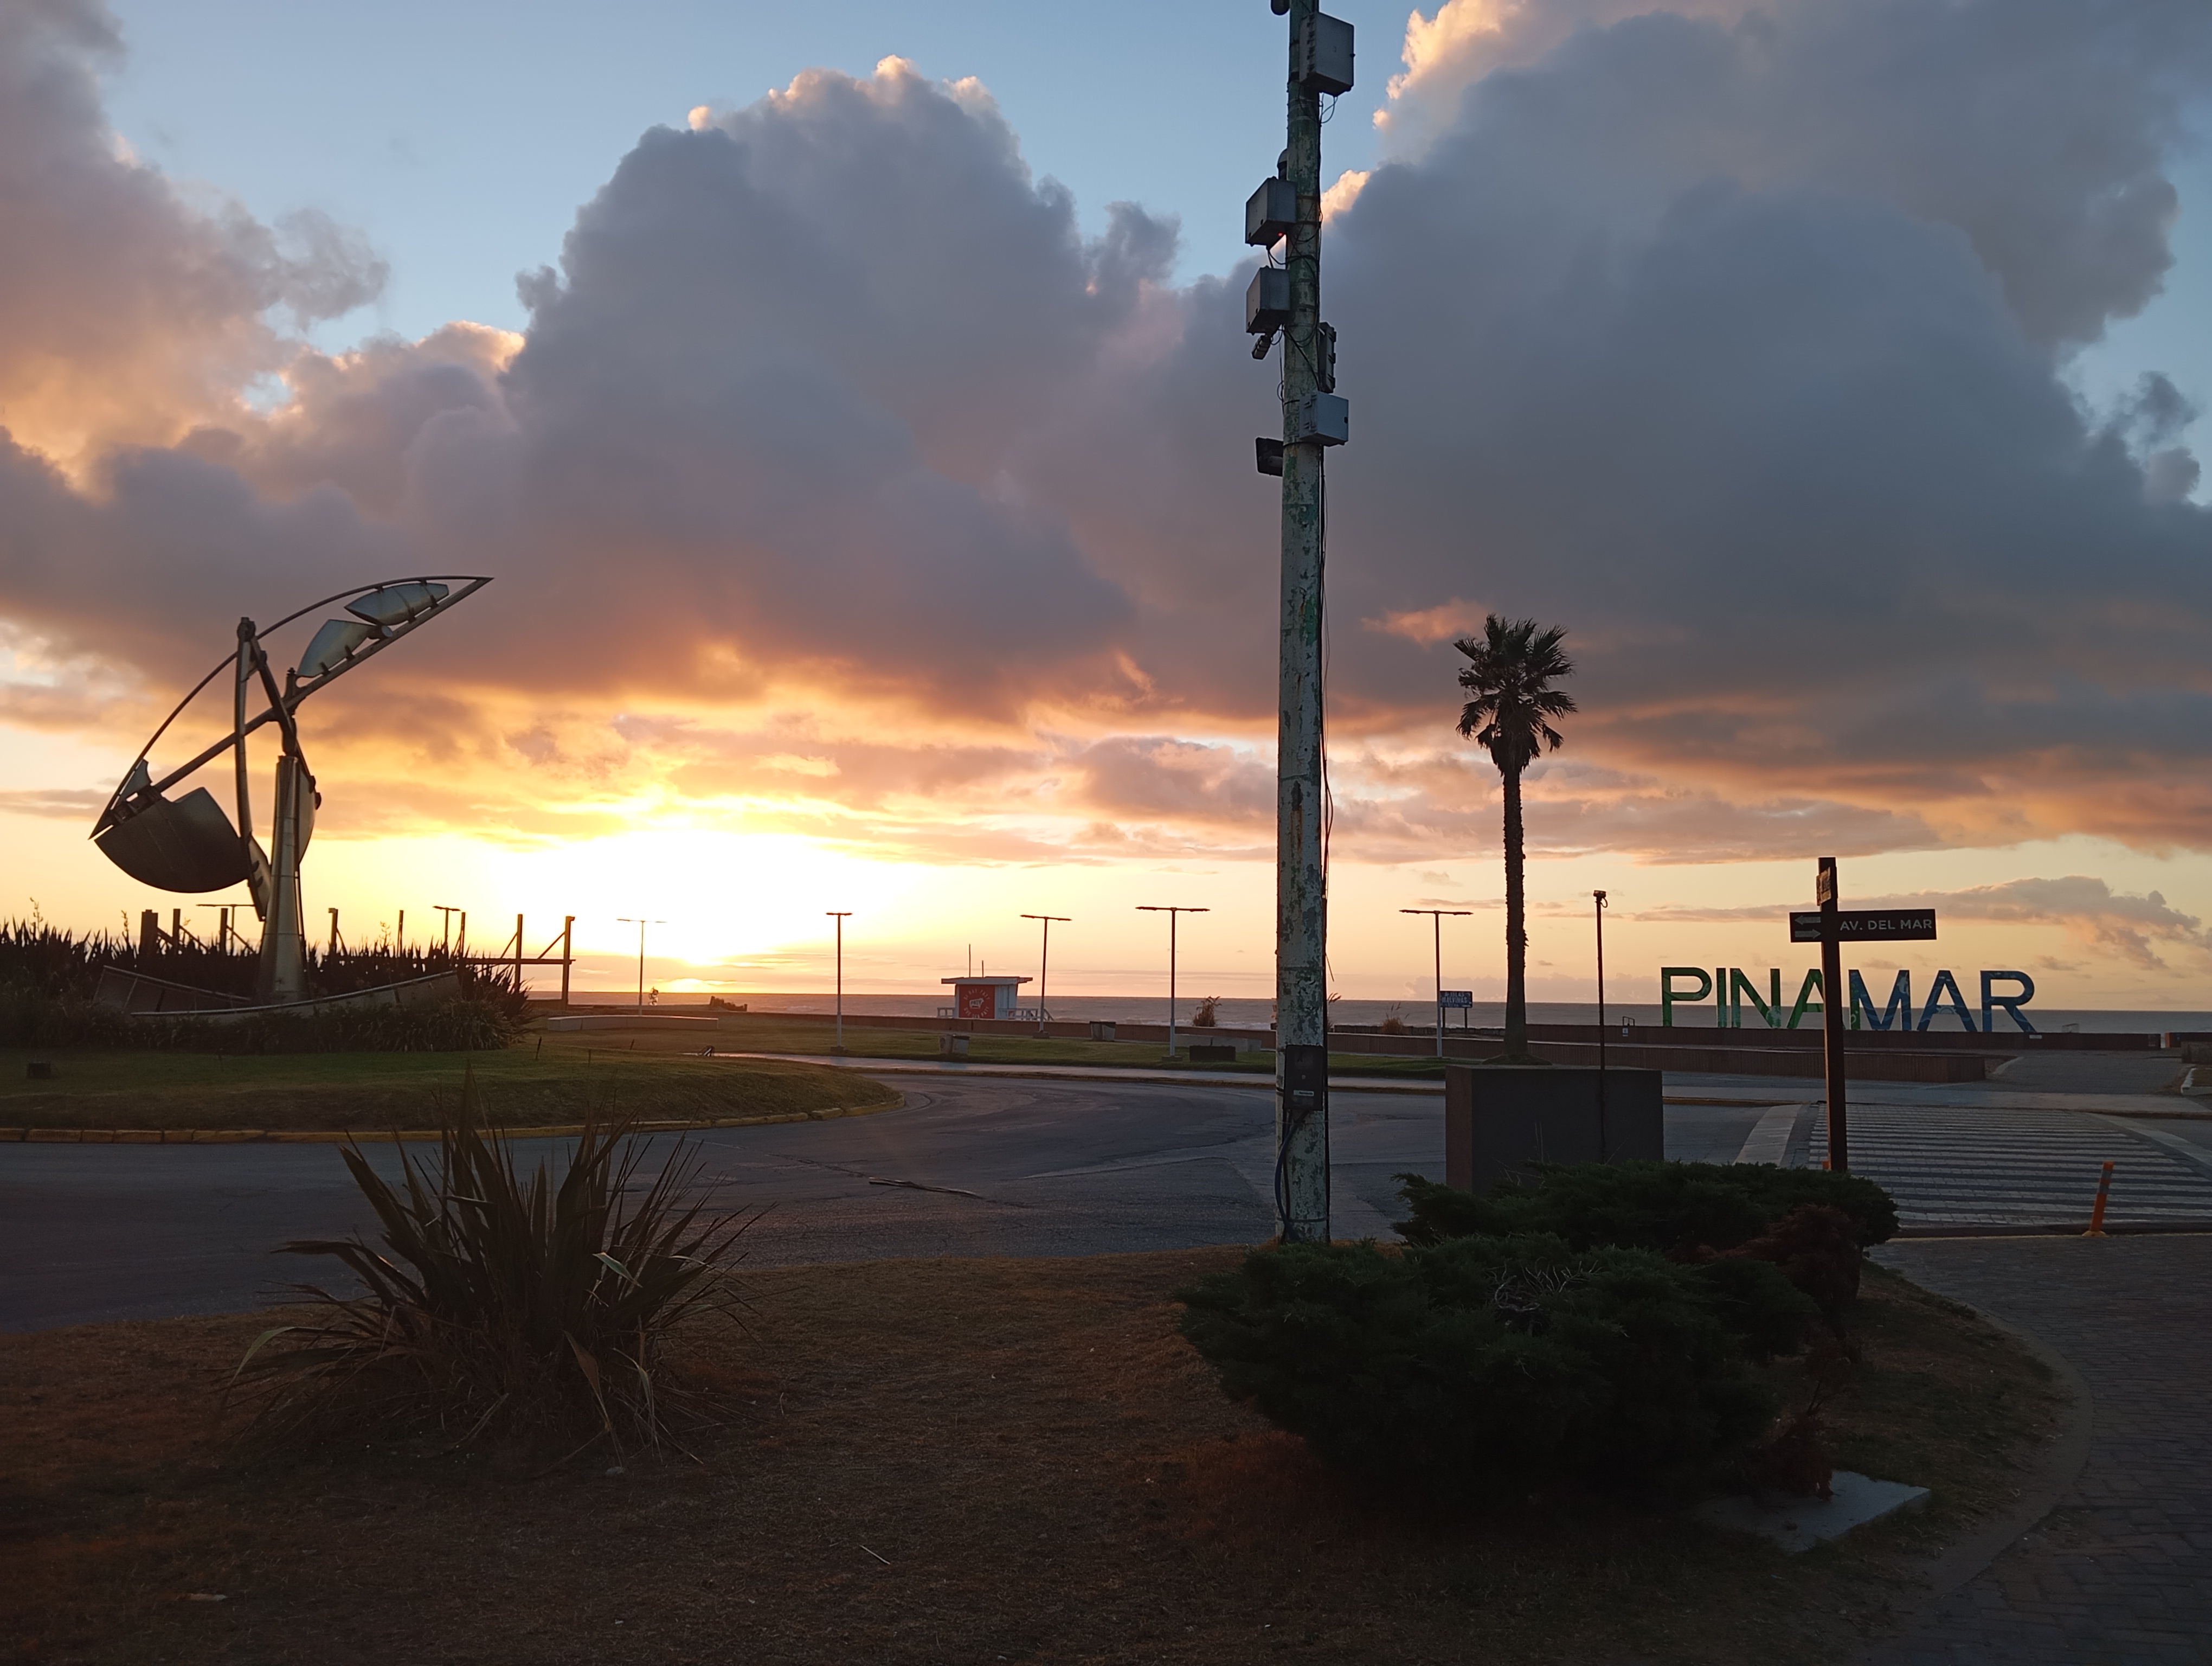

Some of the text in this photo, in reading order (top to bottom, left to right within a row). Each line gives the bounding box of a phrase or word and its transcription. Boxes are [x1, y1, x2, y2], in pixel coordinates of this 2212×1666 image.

[1840, 919, 1932, 931] AV. DEL MAR
[1661, 967, 2037, 1033] PINAMAR
